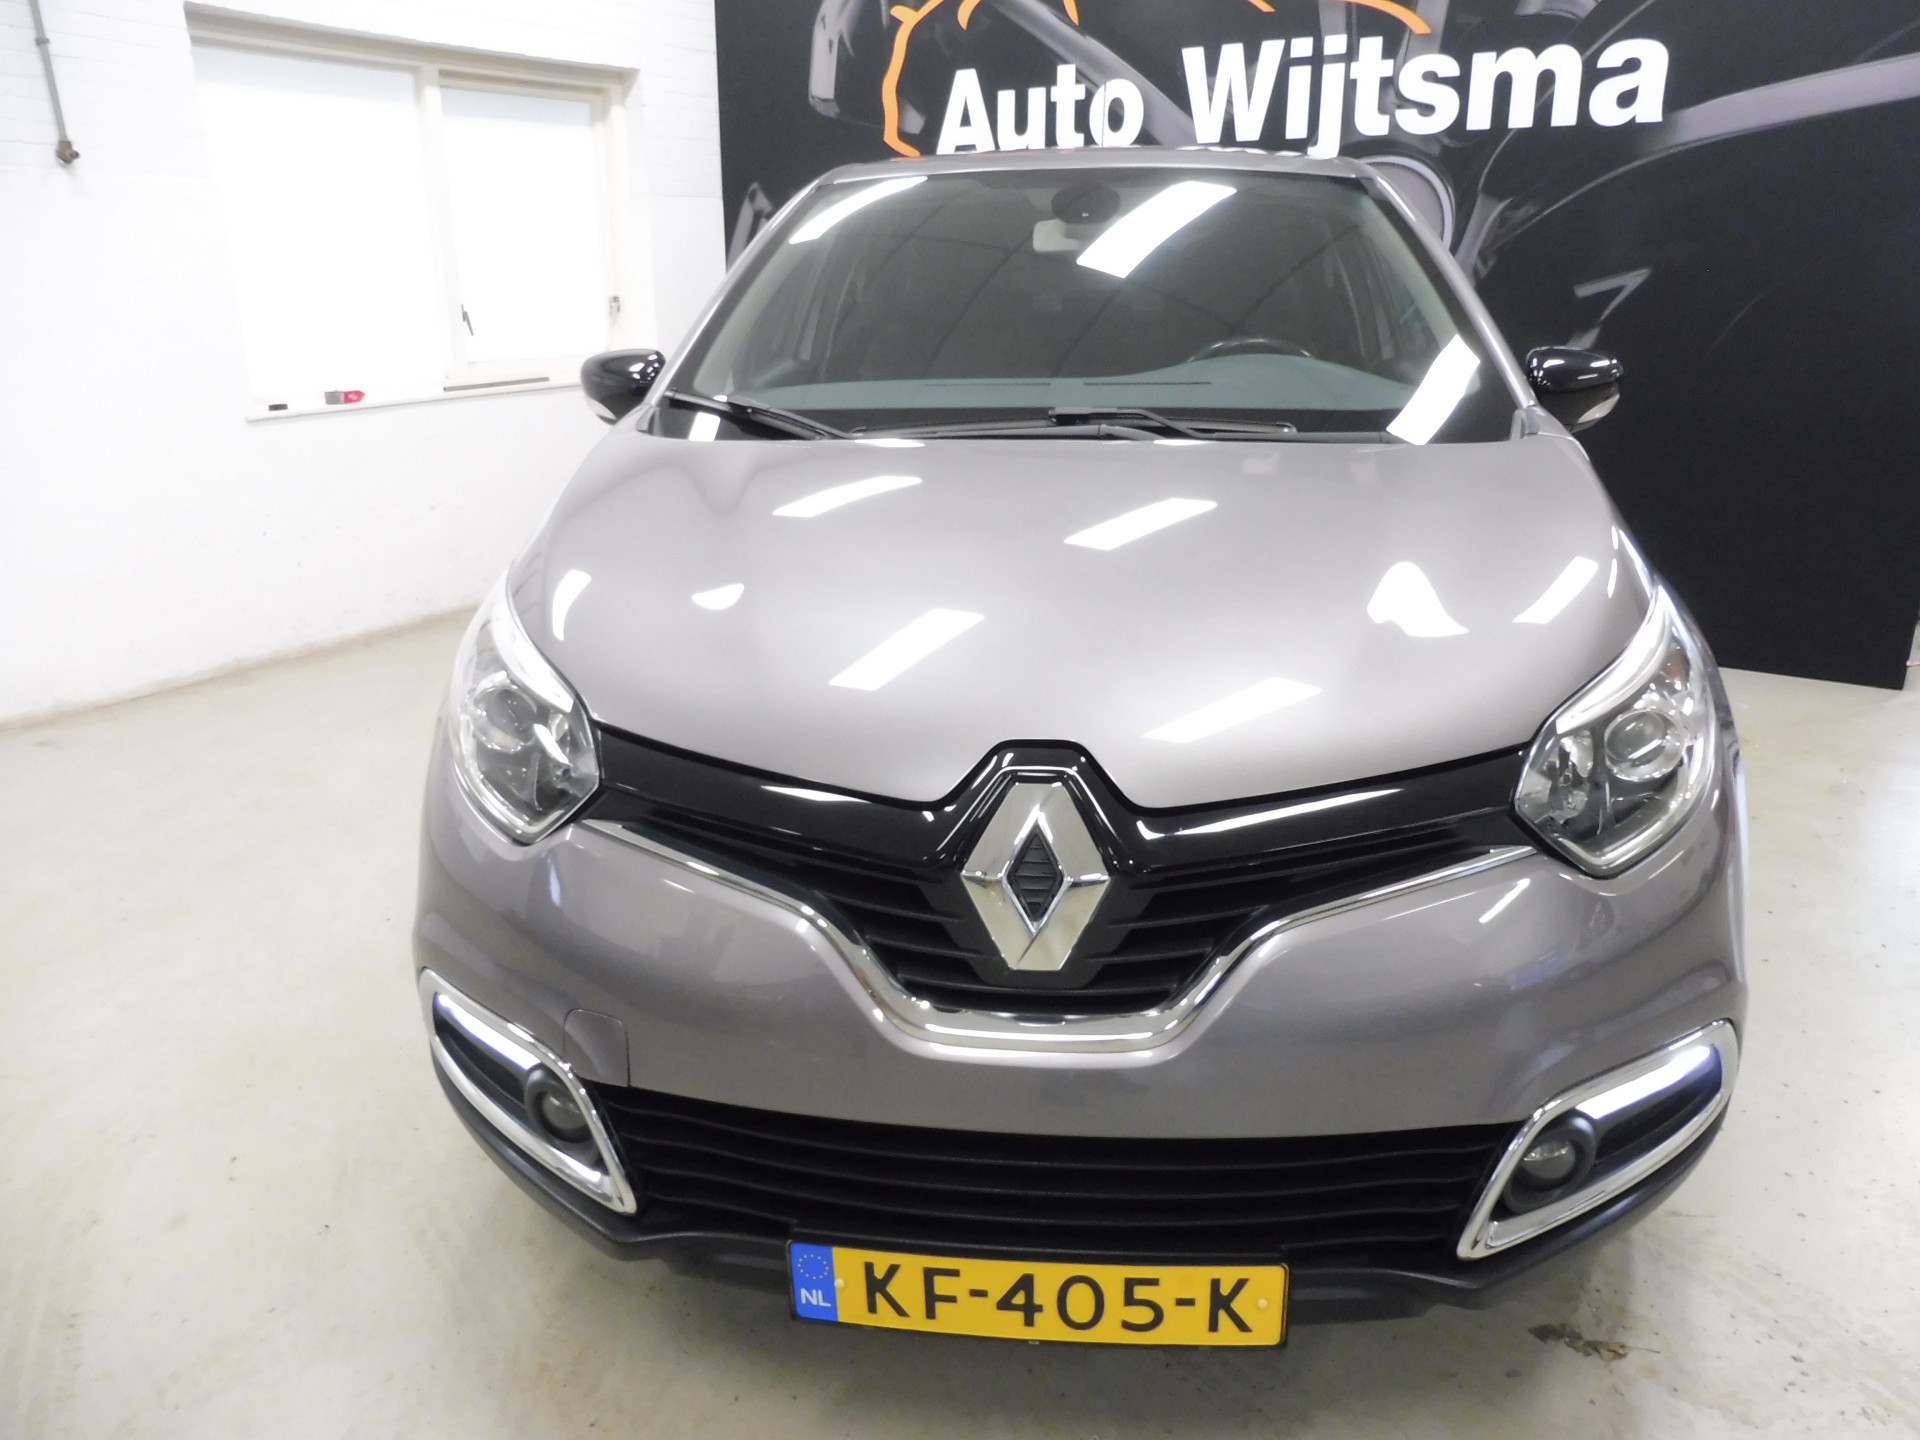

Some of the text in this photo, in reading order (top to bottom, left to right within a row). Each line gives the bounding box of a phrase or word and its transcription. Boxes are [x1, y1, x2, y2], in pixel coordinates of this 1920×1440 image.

[936, 34, 1670, 160] Auto Wijtsma
[799, 1288, 831, 1308] NL
[863, 1261, 1254, 1334] KF-405-K
